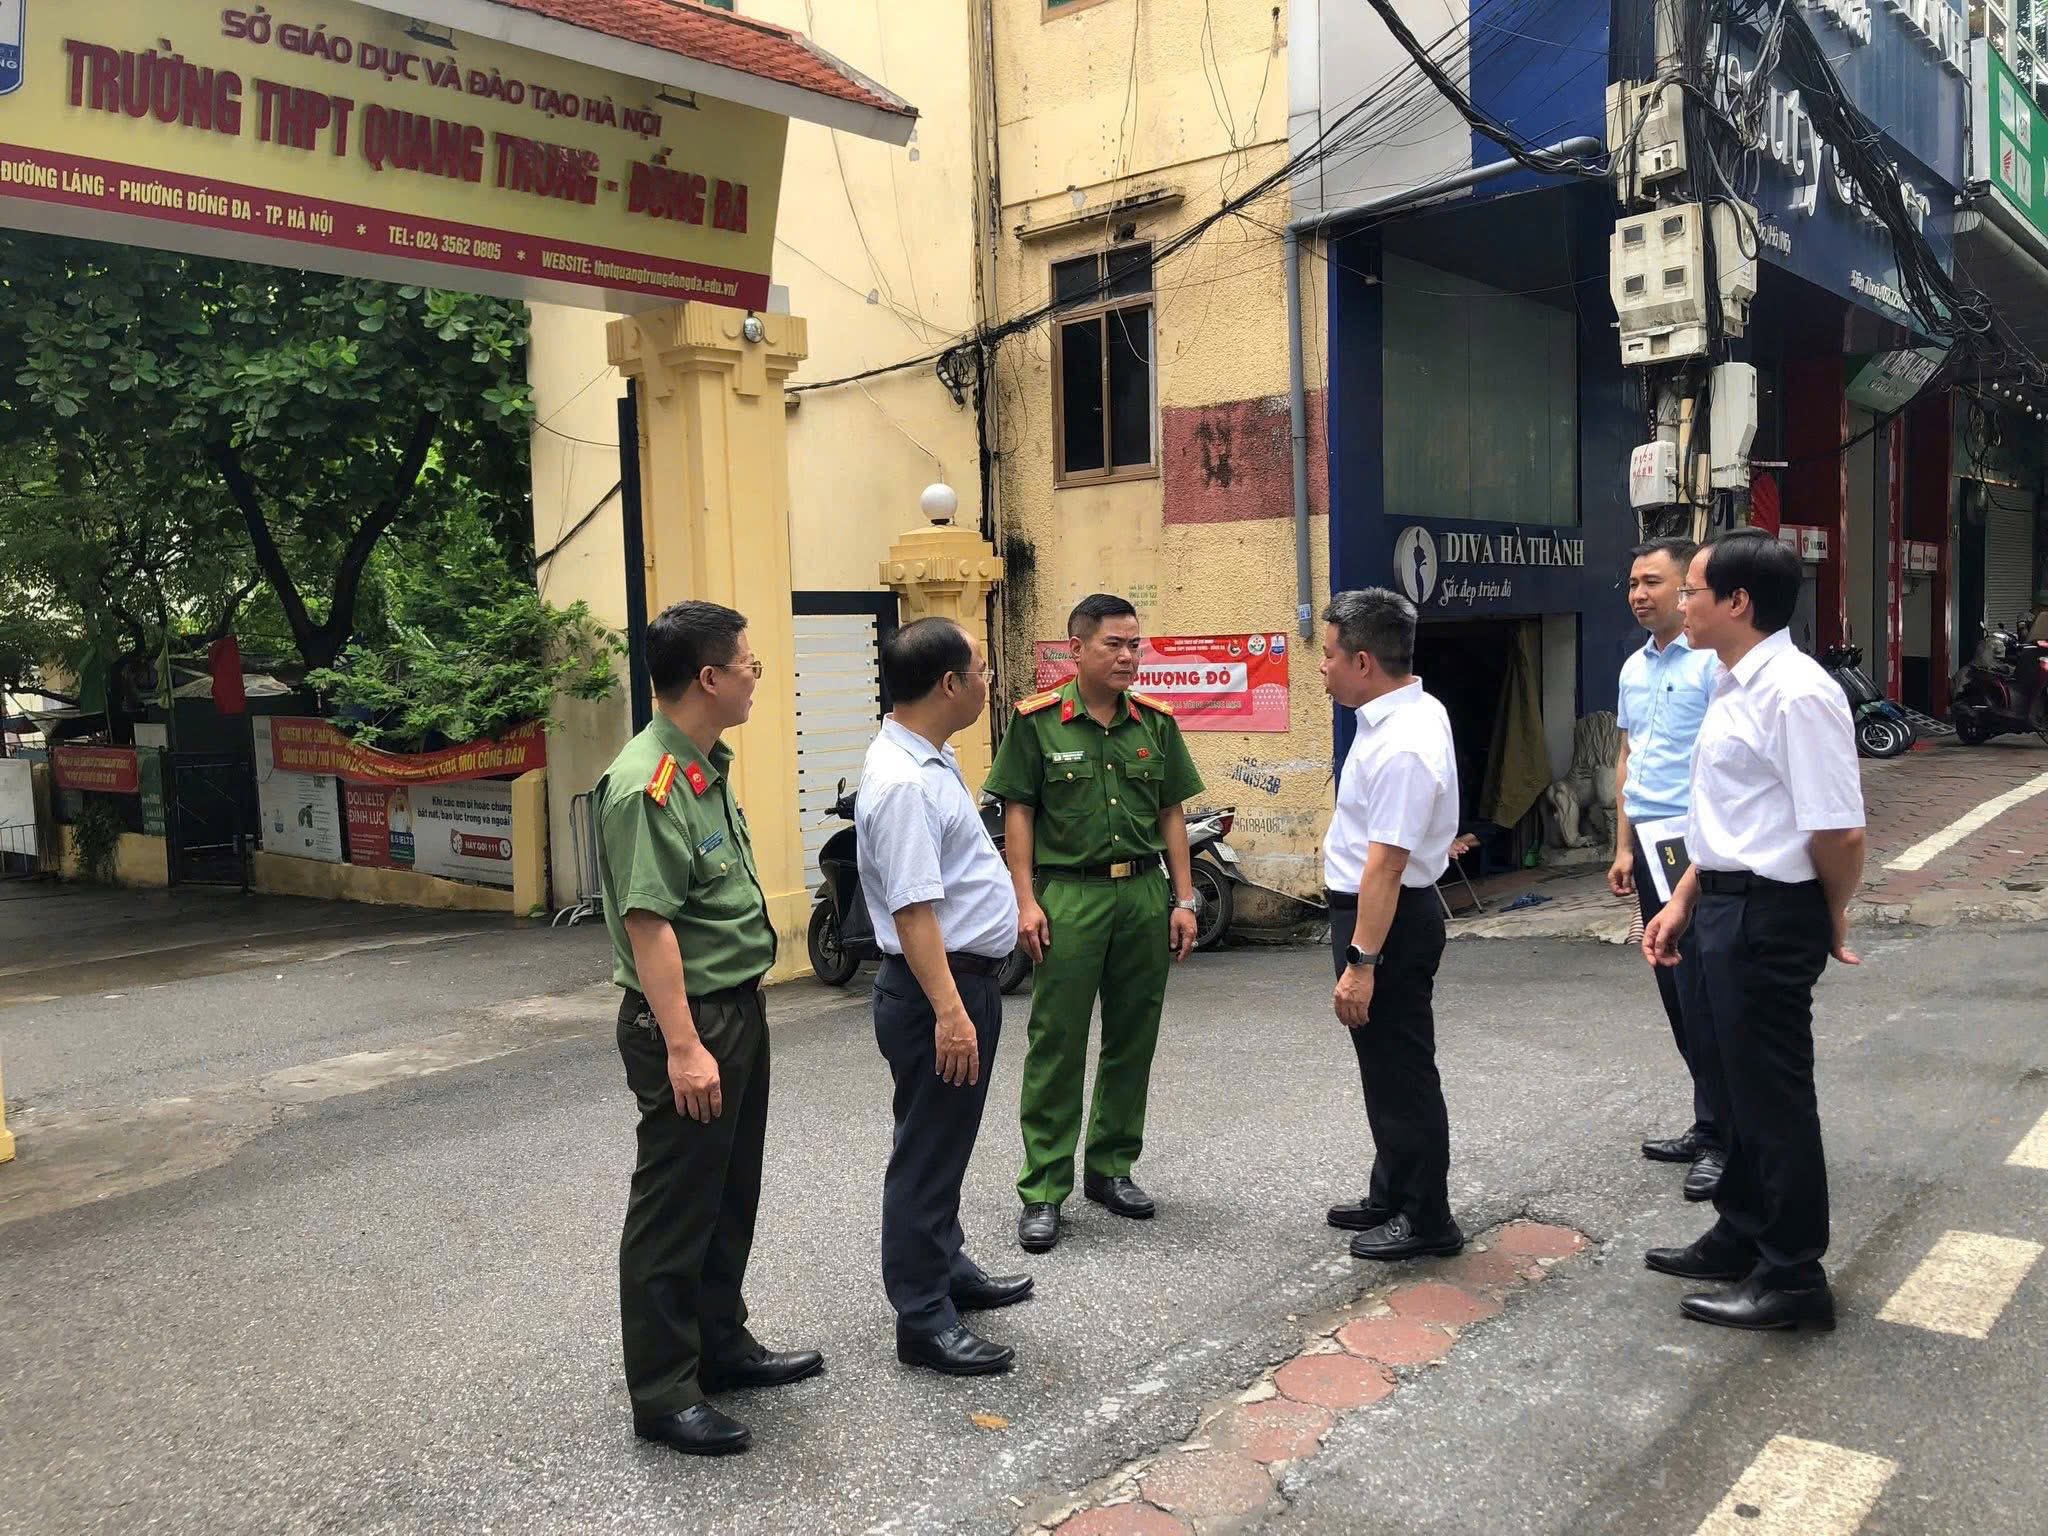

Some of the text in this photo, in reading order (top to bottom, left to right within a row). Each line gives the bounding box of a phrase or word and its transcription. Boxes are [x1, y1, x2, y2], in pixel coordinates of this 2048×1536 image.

[222, 5, 662, 140] SỞ GIÁO DỤC VÀ ĐÀO TẠO HÀ NỘI
[66, 38, 243, 136] TRƯỜNG
[255, 78, 354, 157] THPT
[365, 104, 484, 183] QUANG
[495, 131, 599, 206] TRUNG
[628, 147, 708, 226] ĐỐNG
[711, 179, 748, 234] ĐA
[0, 160, 58, 189] ĐƯỜNG
[62, 168, 105, 197] LÁNG
[120, 180, 183, 209] PHƯỜNG
[187, 187, 228, 217] ĐỐNG
[232, 198, 252, 221] ĐA
[265, 204, 283, 226] TP.
[287, 206, 306, 230] HÀ
[310, 210, 334, 237] NỘI
[416, 231, 439, 251] 024
[441, 235, 471, 256] 3562
[473, 239, 502, 261] 0805
[541, 250, 592, 274] WEBSITE:
[1445, 526, 1585, 567] DIVA HÀ THÀNH
[1459, 578, 1477, 606] đẹp
[1205, 666, 1231, 686] ĐỎ
